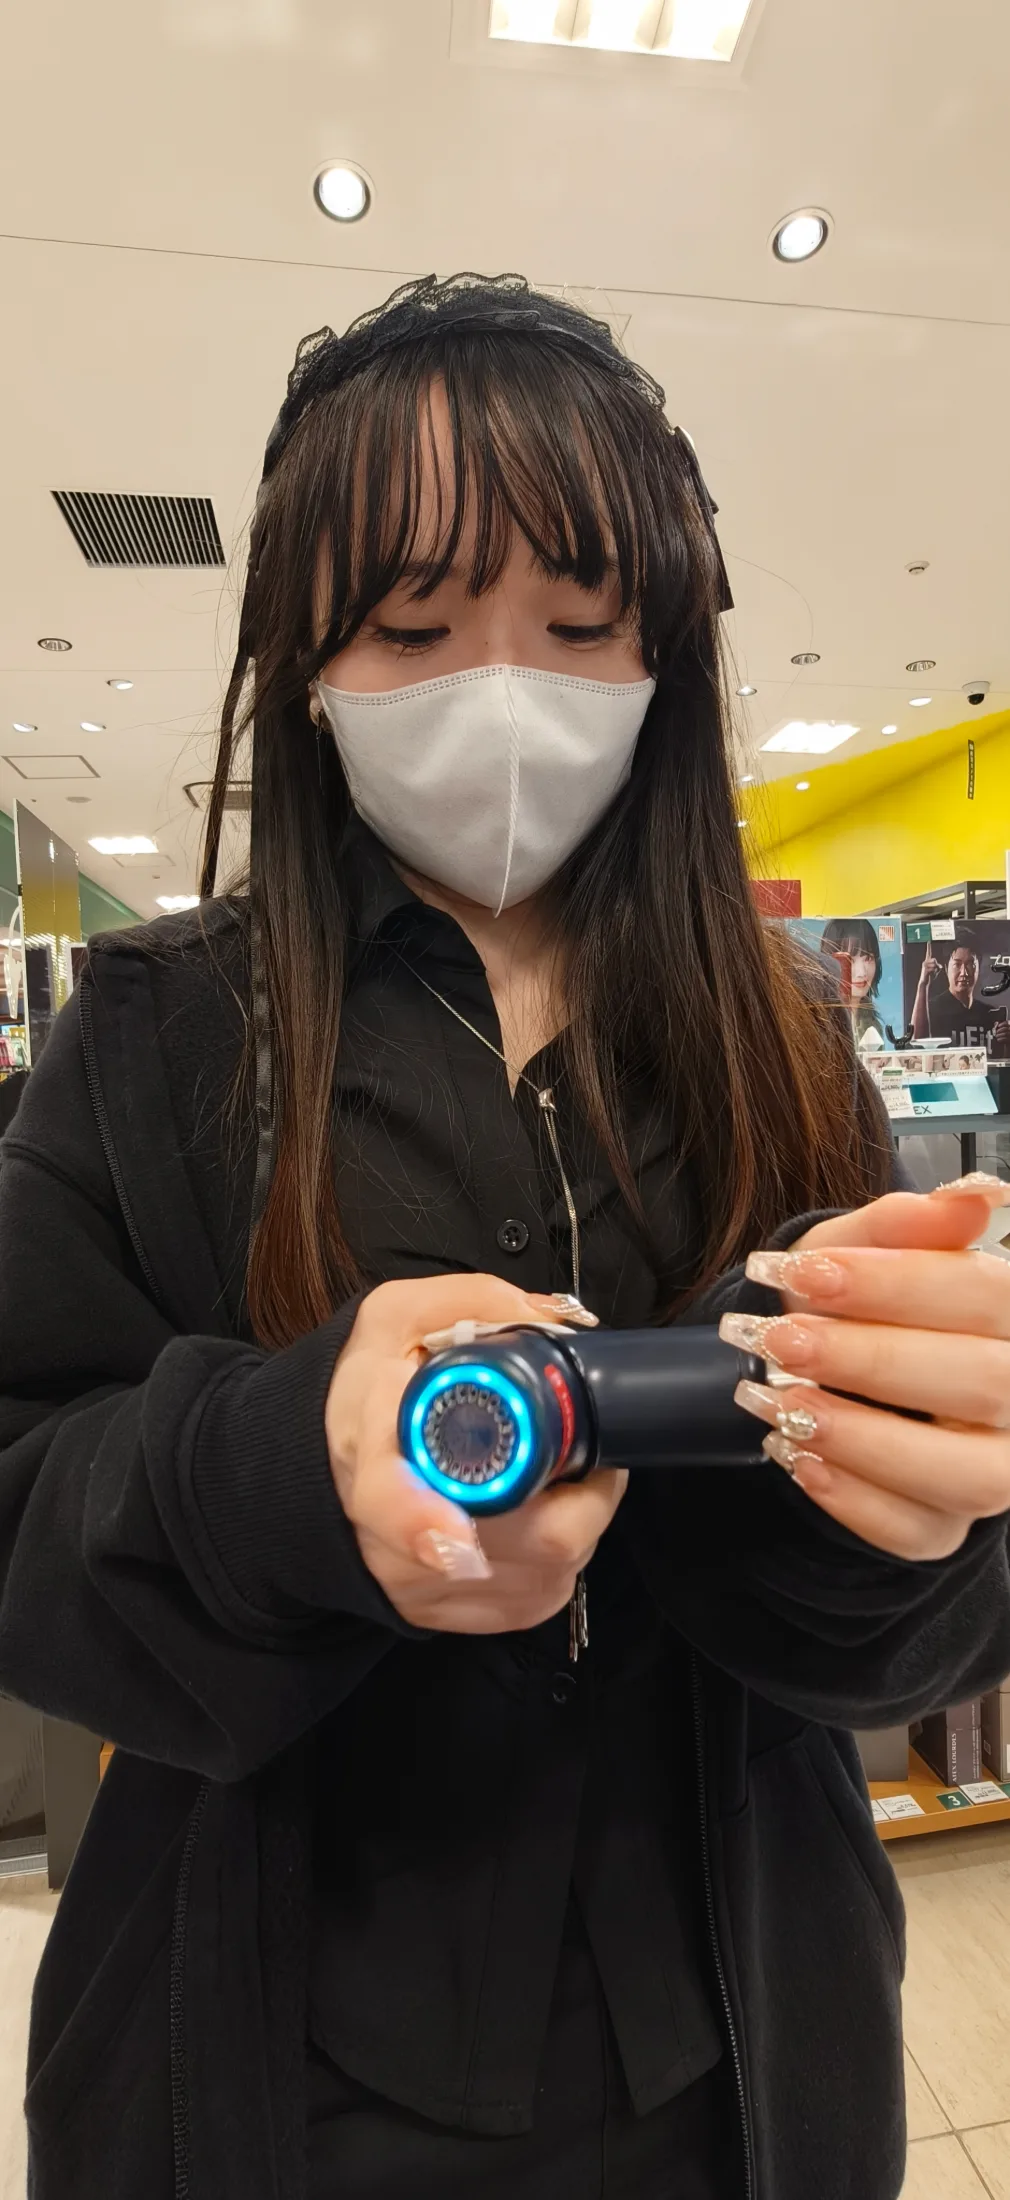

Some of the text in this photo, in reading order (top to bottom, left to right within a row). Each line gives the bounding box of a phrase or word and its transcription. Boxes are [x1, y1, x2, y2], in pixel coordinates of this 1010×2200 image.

[915, 928, 920, 941] 1
[914, 1105, 932, 1115] EX
[947, 1795, 961, 1806] 3
